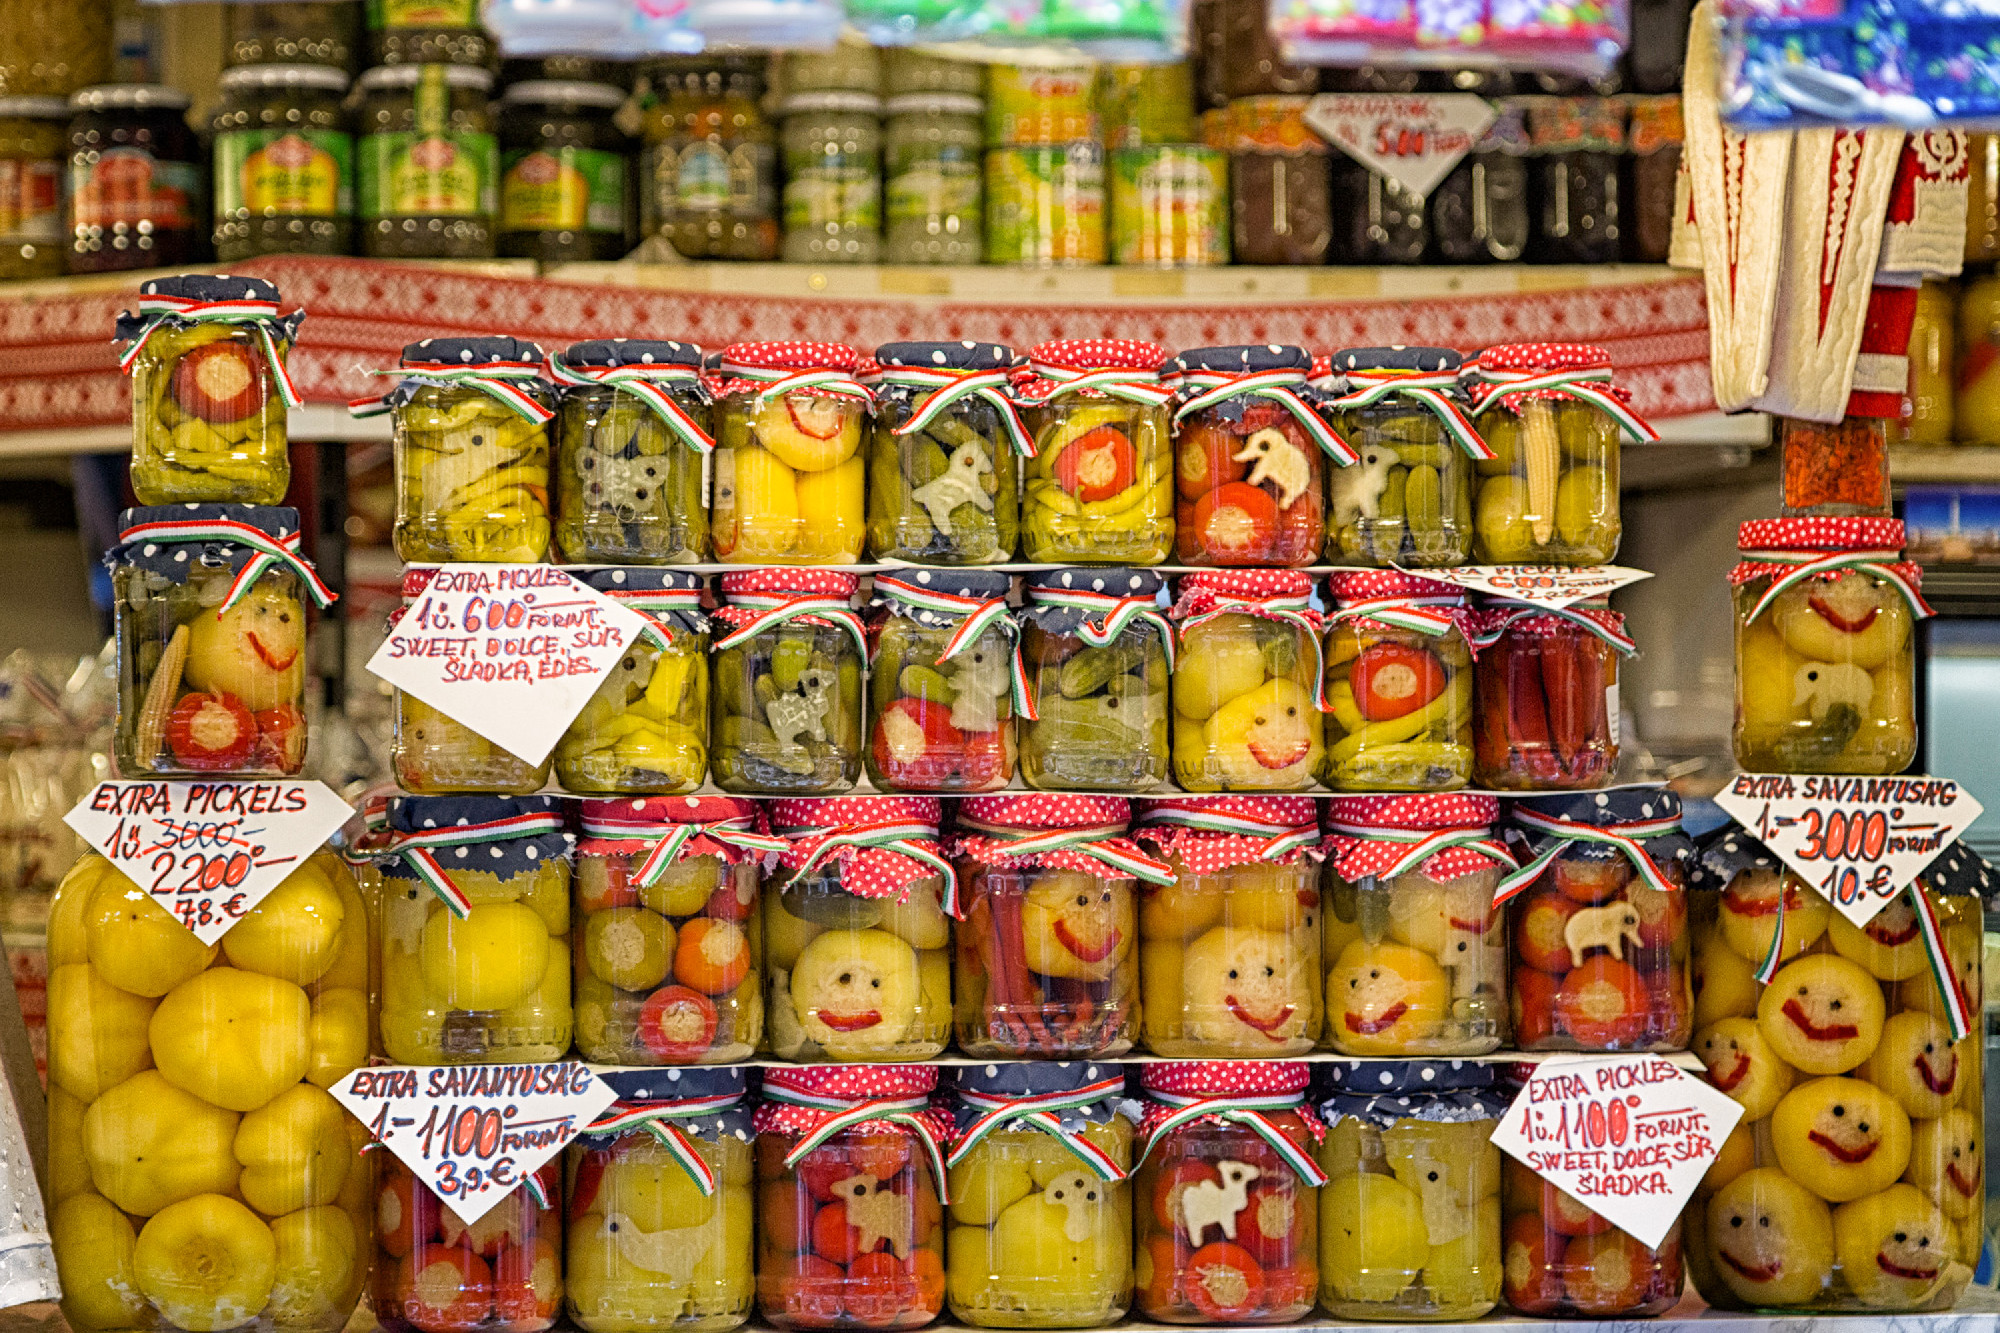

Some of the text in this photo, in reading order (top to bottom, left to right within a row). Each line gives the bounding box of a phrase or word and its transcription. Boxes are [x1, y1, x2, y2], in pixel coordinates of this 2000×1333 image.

[433, 570, 496, 594] EXTRA
[90, 783, 308, 816] EXTRA PICKELS
[1732, 773, 1797, 800] EXTRA
[349, 1069, 419, 1100] EXTRA
[1529, 1073, 1592, 1105] EXTRA
